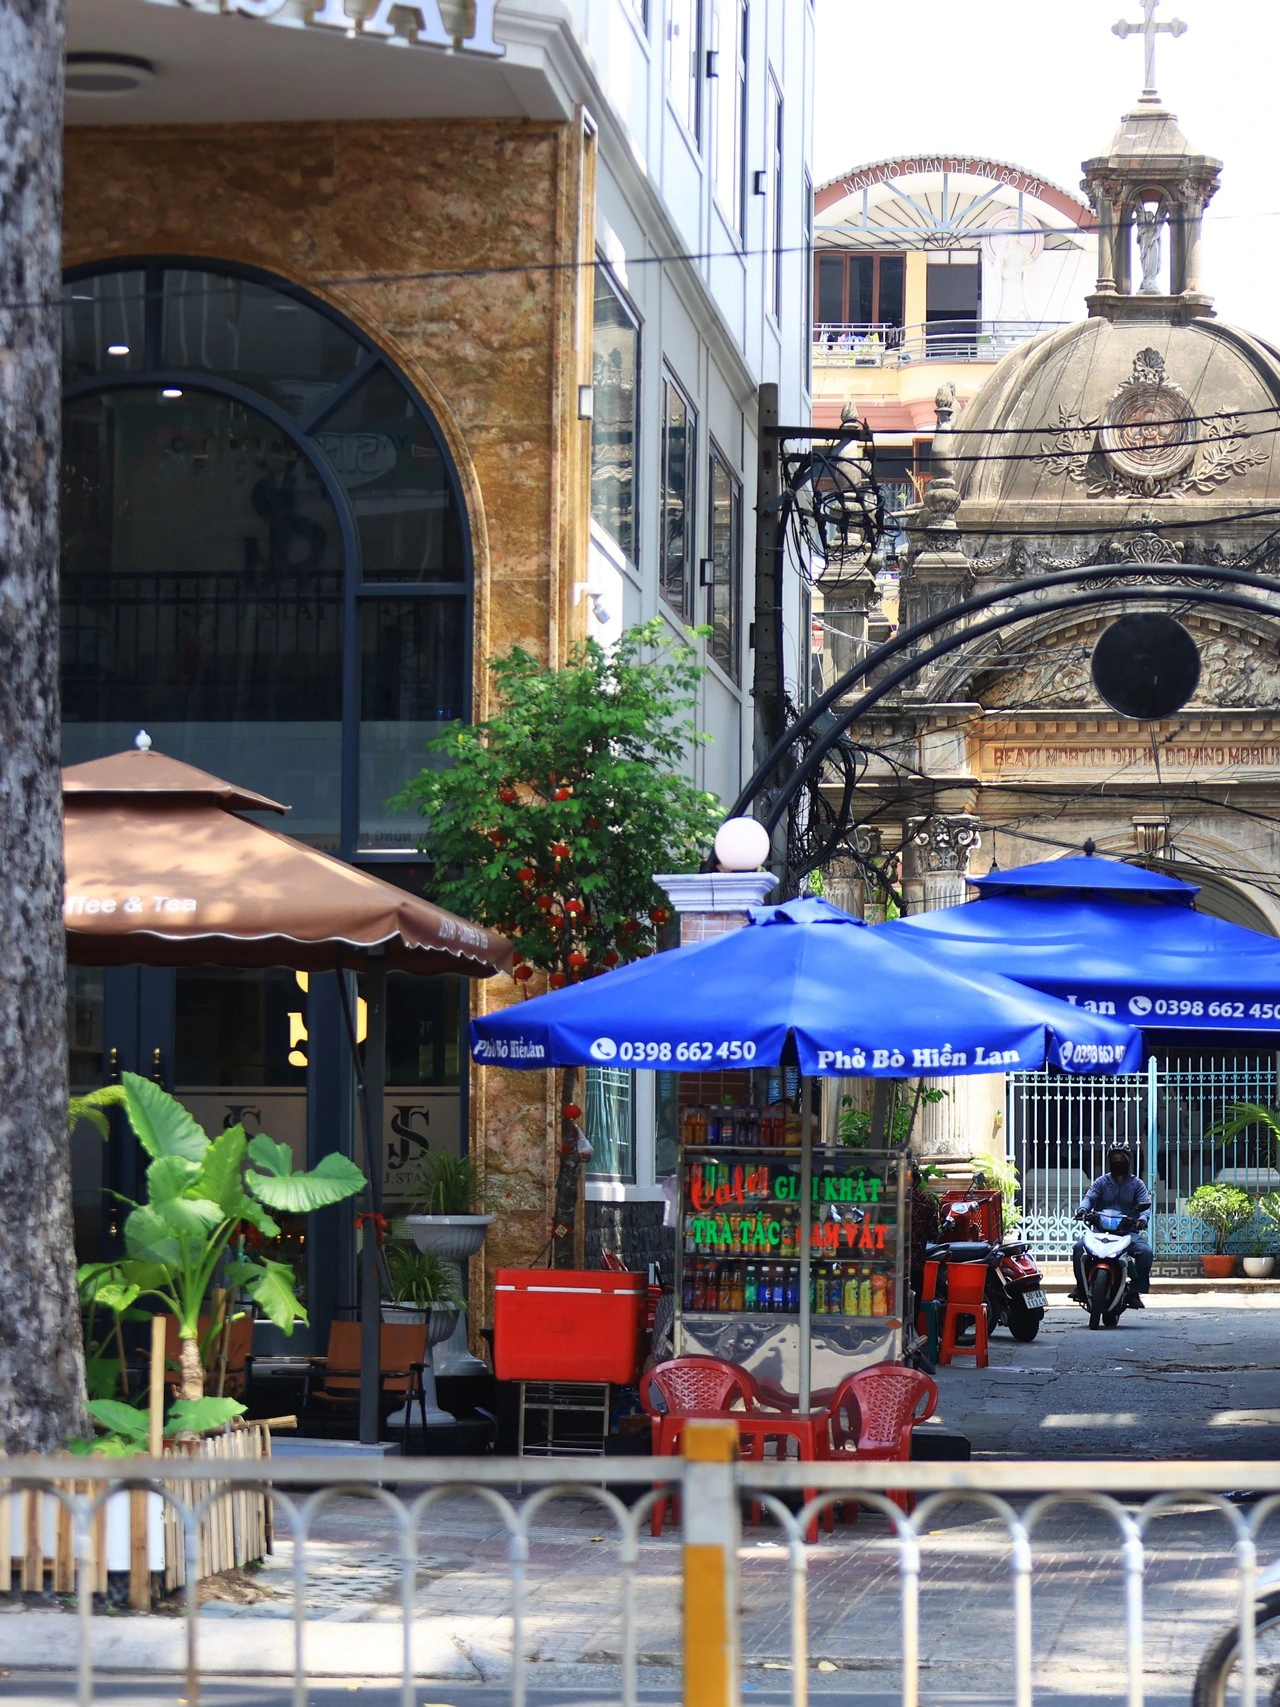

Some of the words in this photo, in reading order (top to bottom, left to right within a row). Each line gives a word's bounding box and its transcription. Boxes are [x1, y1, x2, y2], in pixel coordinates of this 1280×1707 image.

[843, 174, 874, 195] NAM
[993, 748, 1041, 767] BEATI
[124, 896, 144, 913] &
[152, 896, 197, 913] Tea
[1155, 999, 1204, 1016] 0398
[1208, 1001, 1245, 1018] 662
[619, 1041, 672, 1061] 0398
[675, 1041, 712, 1061] 662
[715, 1040, 757, 1060] 450
[817, 1047, 866, 1070] Phở
[872, 1047, 906, 1069] Bò
[912, 1043, 967, 1068] Hiền
[974, 1046, 1020, 1066] Lan
[774, 1175, 819, 1200] GII
[824, 1171, 882, 1201] KHÁT
[692, 1213, 733, 1245] TRÀ
[739, 1210, 781, 1246] TẮC
[795, 1221, 839, 1248] AM
